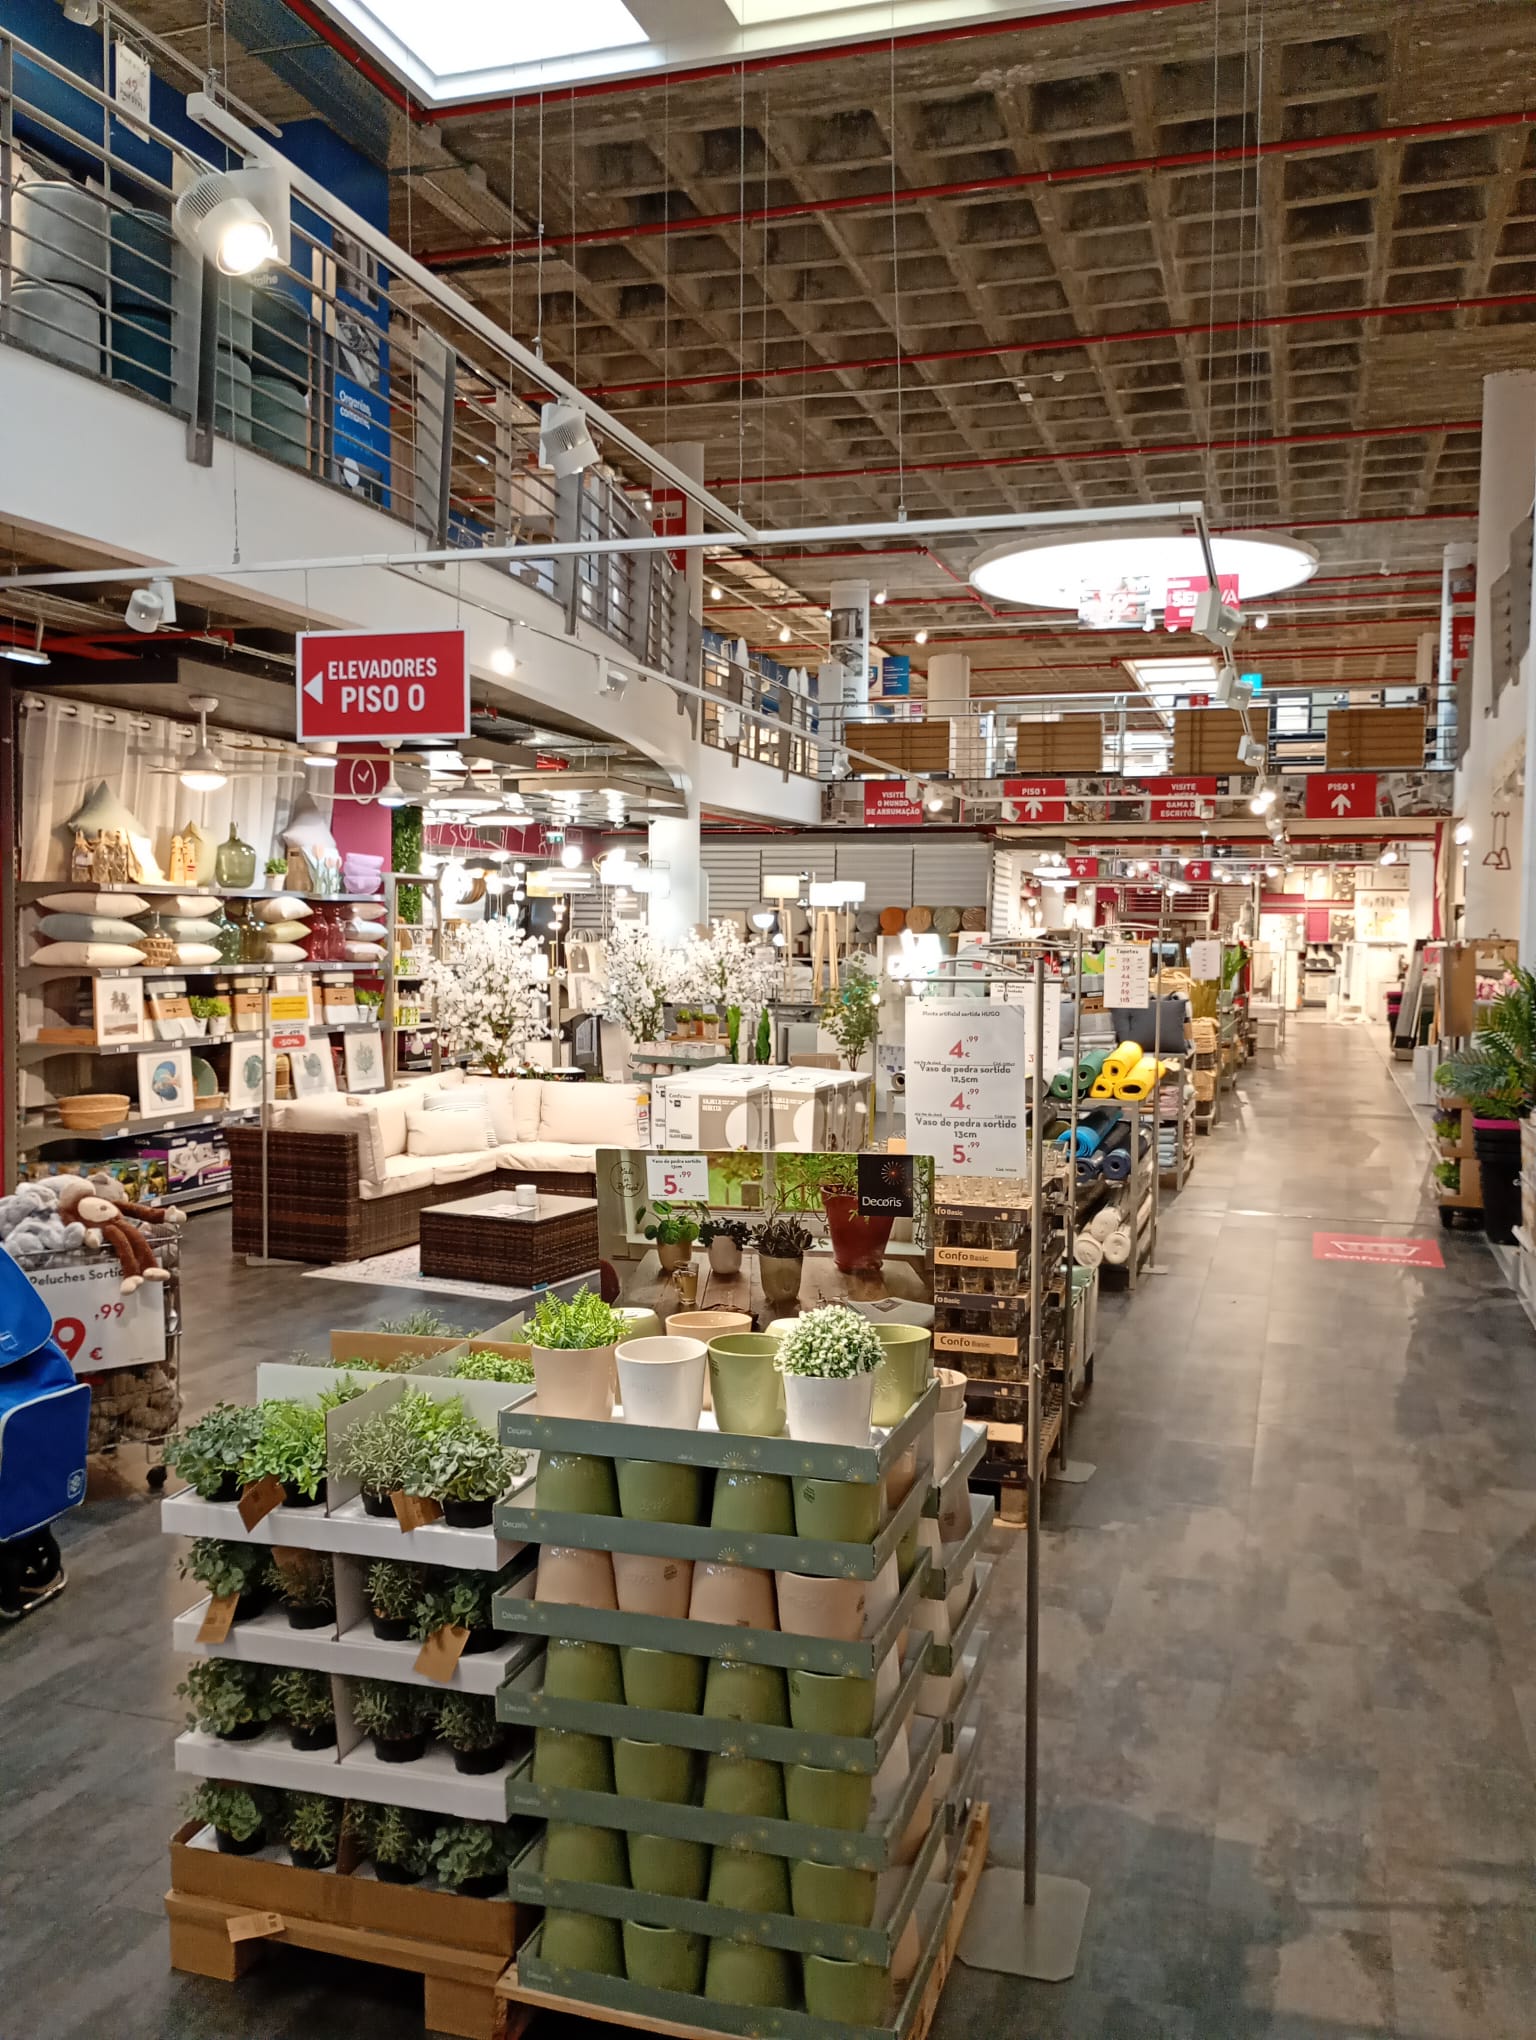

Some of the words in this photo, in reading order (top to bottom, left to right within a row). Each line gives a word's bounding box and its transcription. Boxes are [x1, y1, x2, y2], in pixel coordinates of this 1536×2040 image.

[328, 657, 438, 680] ELEVADORES
[341, 684, 399, 713] PISO
[1021, 787, 1041, 796] PISO
[1042, 787, 1047, 796] 1
[1171, 783, 1197, 791] VISITE
[1328, 783, 1349, 791] PISO
[1350, 783, 1356, 791] 1
[877, 806, 920, 816] ARRUMAÇÃO
[949, 1039, 964, 1058] 4
[920, 1063, 939, 1072] Vaso
[941, 1065, 951, 1073] de
[953, 1065, 978, 1074] pedra
[980, 1065, 1011, 1074] sortido
[950, 1092, 965, 1110] 4
[916, 1117, 938, 1126] Vaso
[940, 1117, 952, 1127] de
[953, 1118, 981, 1129] pedra
[983, 1119, 1017, 1129] sortido
[952, 1144, 966, 1164] 5
[663, 1174, 678, 1195] 5
[861, 1196, 903, 1208] Decoris
[947, 1208, 964, 1216] Basic
[938, 1250, 969, 1261] Confo
[969, 1254, 990, 1262] Basic
[30, 1271, 86, 1287] Peluches
[940, 1335, 971, 1347] Confo
[90, 1347, 104, 1361] €
